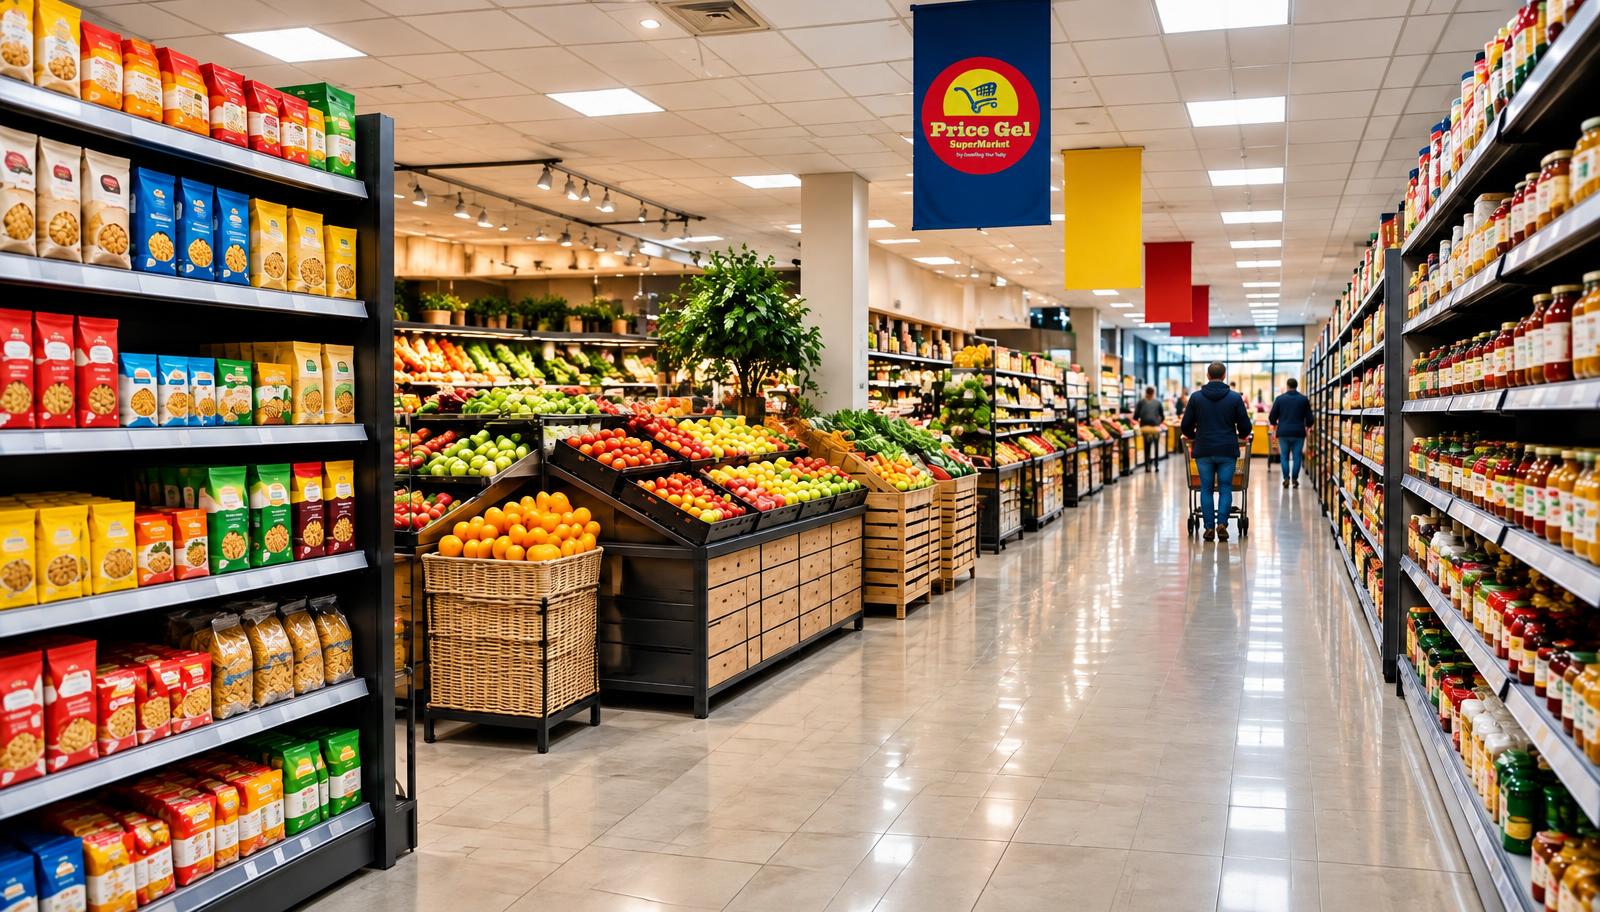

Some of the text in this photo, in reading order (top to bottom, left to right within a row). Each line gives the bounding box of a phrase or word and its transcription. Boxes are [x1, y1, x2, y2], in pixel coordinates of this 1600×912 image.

[930, 121, 1032, 137] Price Gel
[949, 139, 1010, 150] SuperMarket
